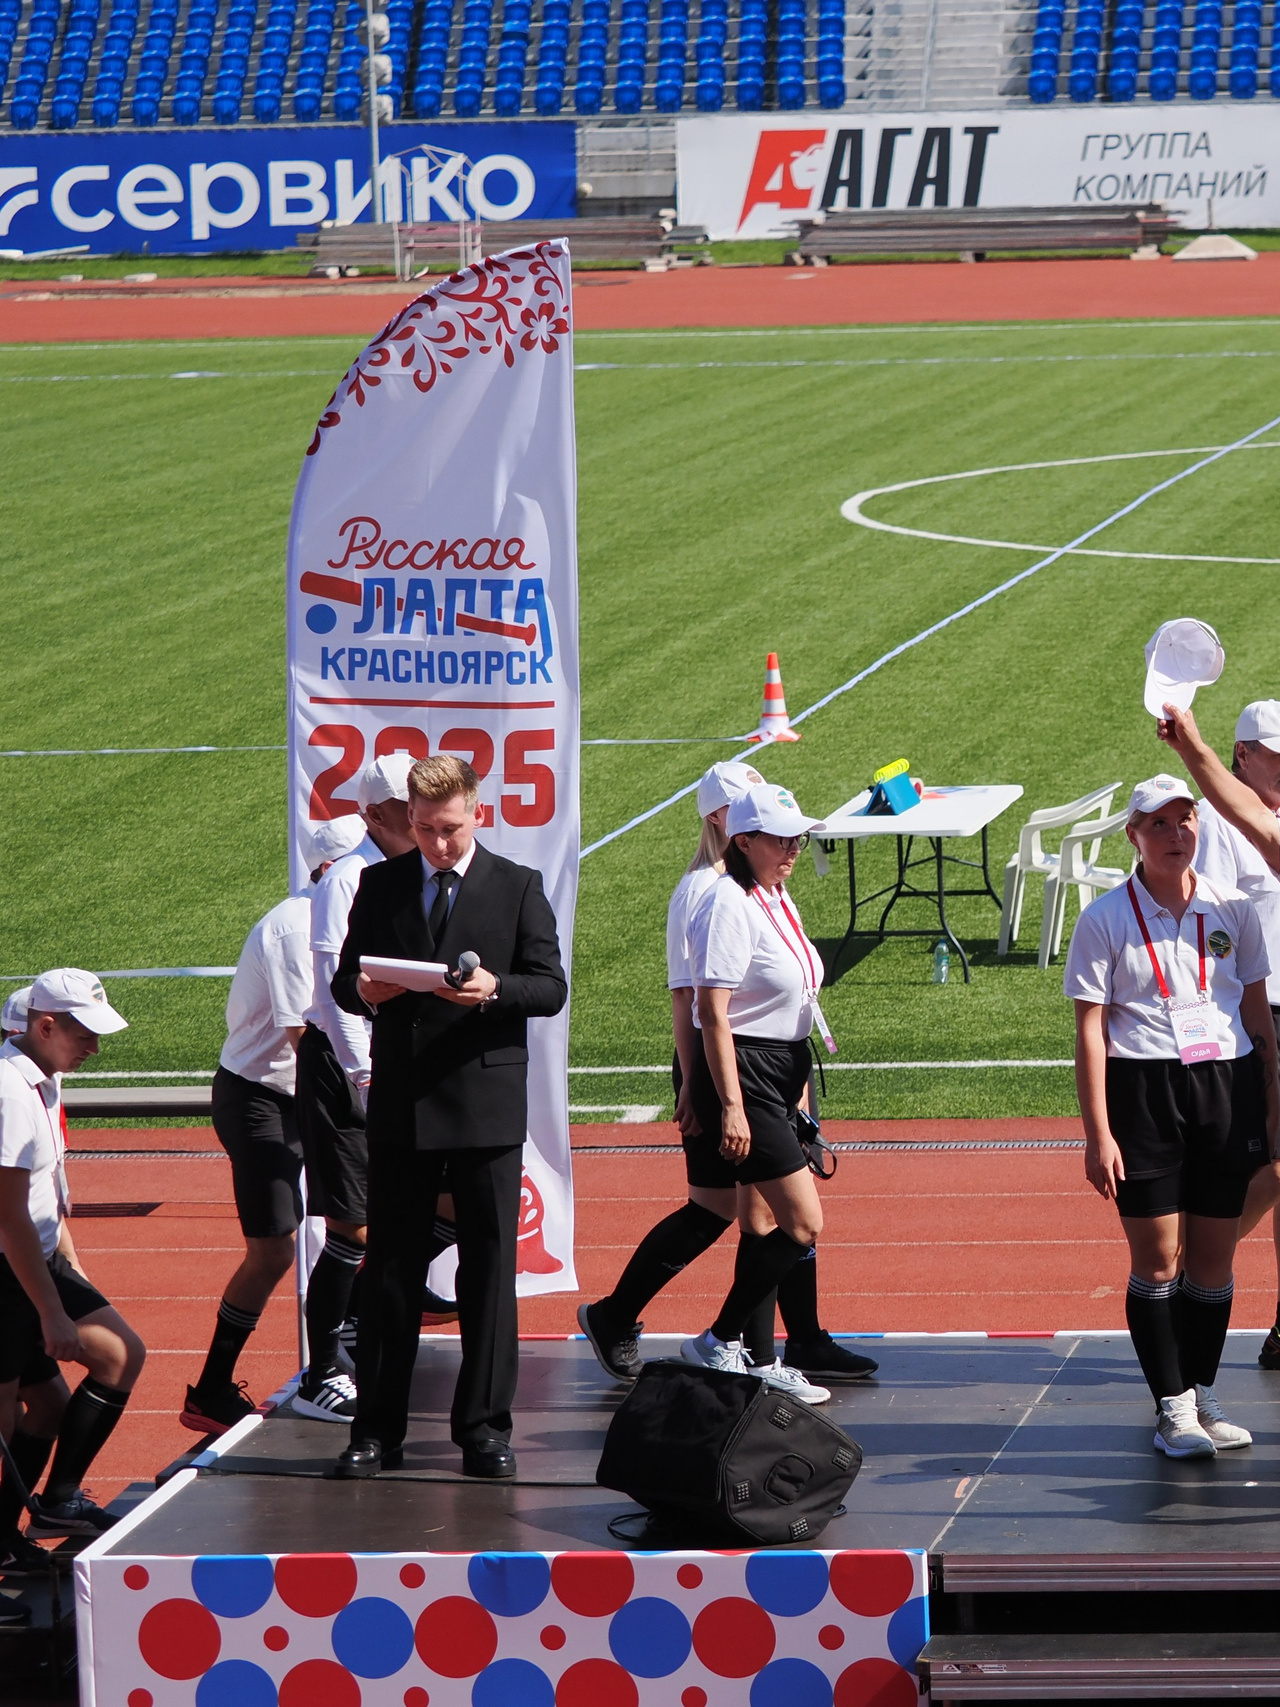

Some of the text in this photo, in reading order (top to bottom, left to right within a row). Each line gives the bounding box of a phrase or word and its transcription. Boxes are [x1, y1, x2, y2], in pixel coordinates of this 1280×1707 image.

[820, 126, 999, 207] АГАТ
[1082, 132, 1212, 161] ГРУППА
[51, 153, 536, 240] сервико
[1074, 164, 1268, 204] КОМПАНИЙ
[327, 516, 537, 571] Русская
[353, 577, 552, 655] ЛАПТА
[321, 646, 554, 686] КРАСНОЯРСК
[1191, 1048, 1211, 1057] СУДЬЯ
